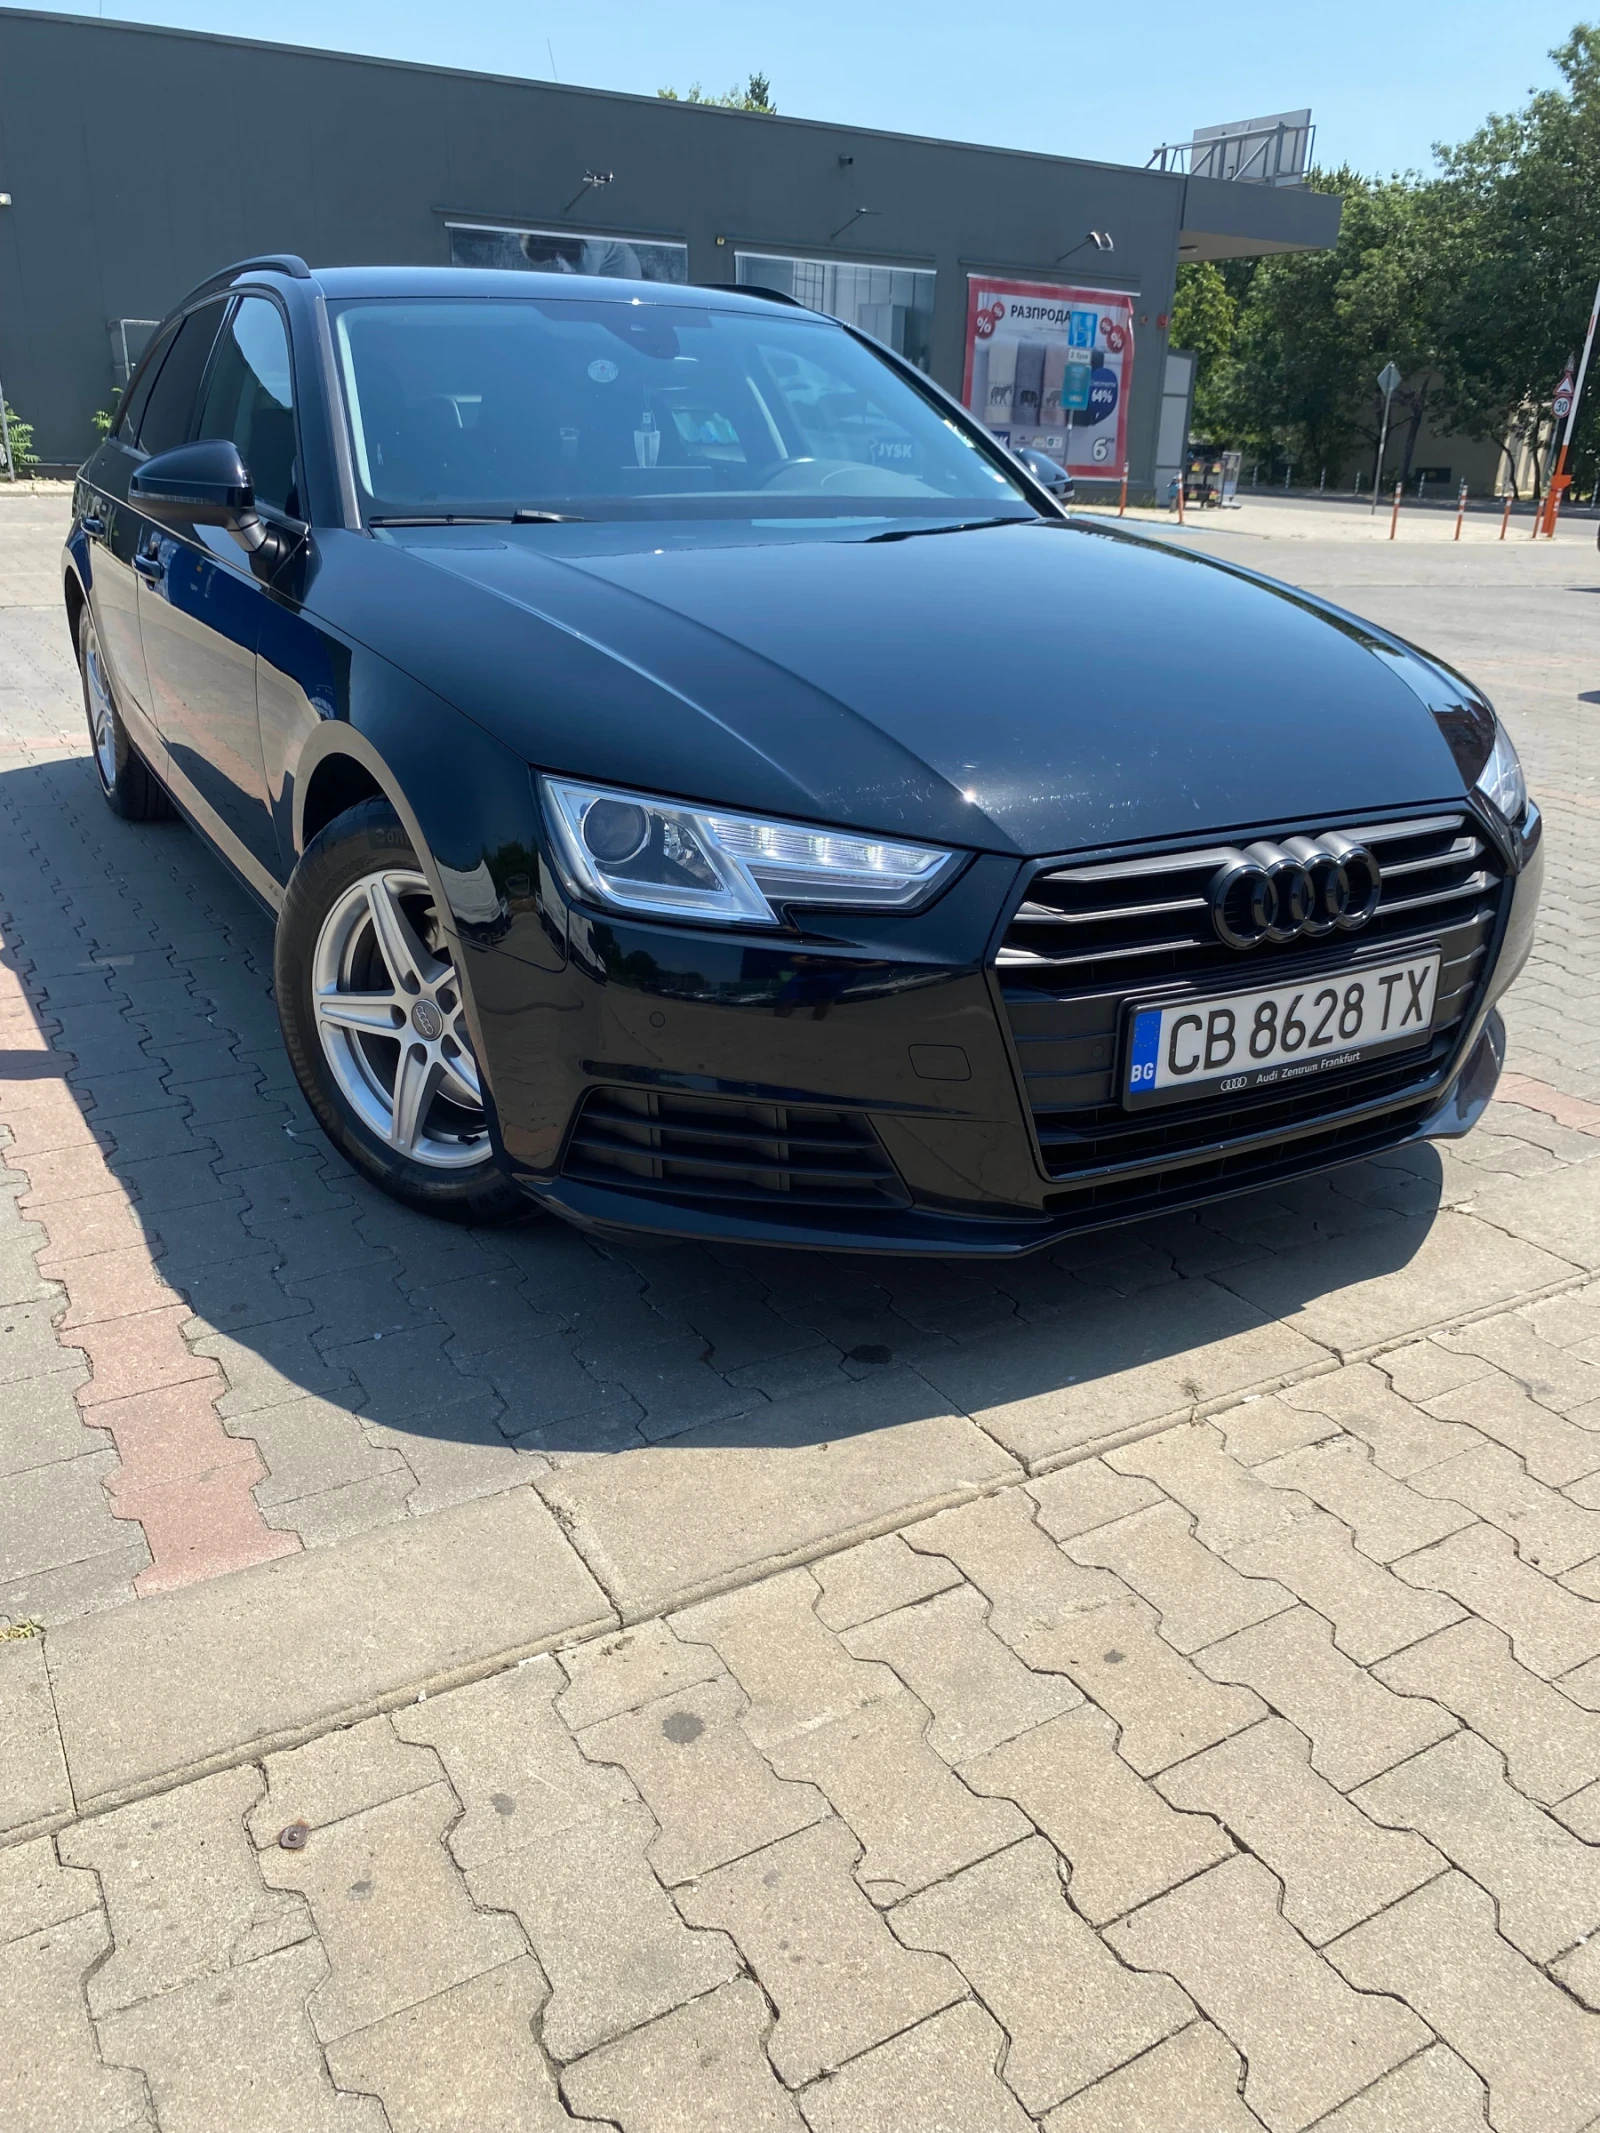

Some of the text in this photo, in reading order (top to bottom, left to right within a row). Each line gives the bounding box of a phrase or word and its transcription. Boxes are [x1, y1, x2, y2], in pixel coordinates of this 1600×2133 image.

[977, 317, 992, 333] %
[1091, 388, 1113, 403] 64%
[1556, 401, 1568, 412] 30
[878, 443, 913, 459] JYSK
[1249, 982, 1365, 1059] 8628
[1130, 1061, 1155, 1083] BG
[1256, 1051, 1361, 1084] Audi Zentrum Frankfurt
